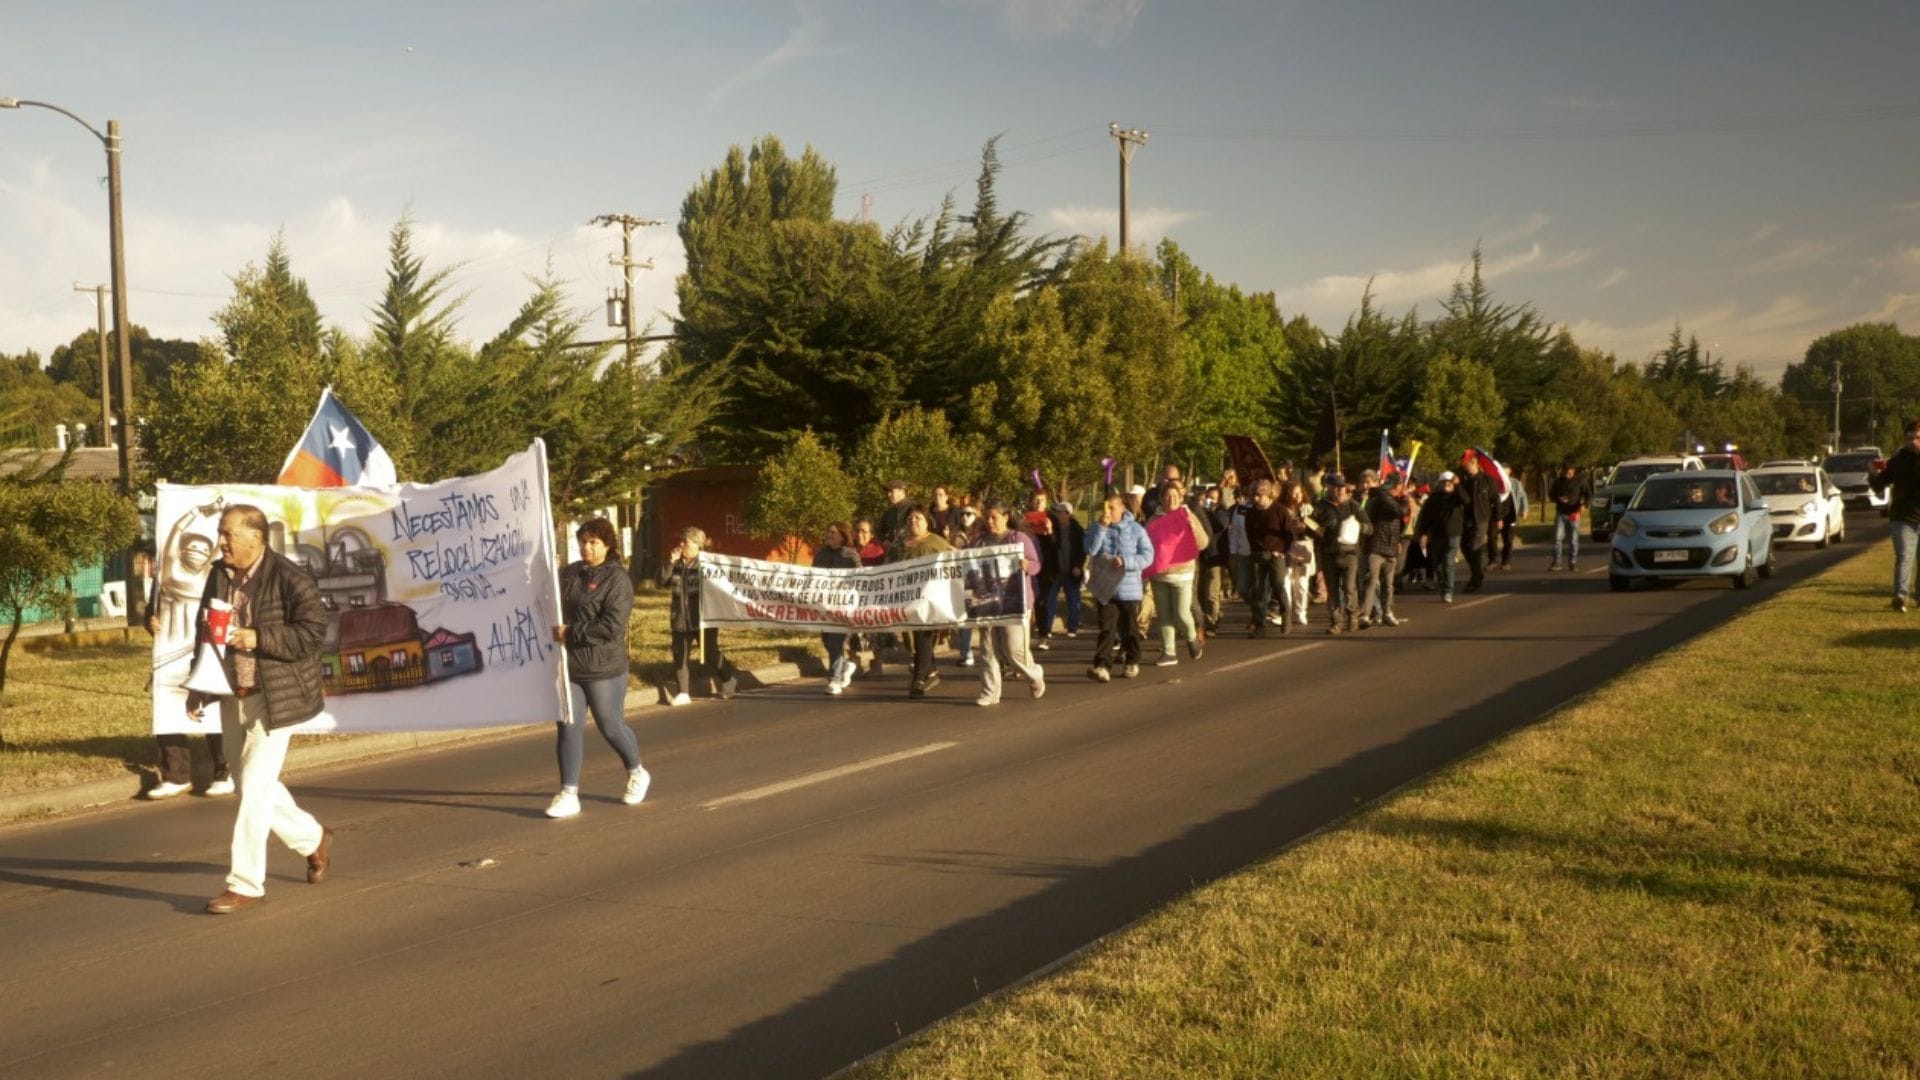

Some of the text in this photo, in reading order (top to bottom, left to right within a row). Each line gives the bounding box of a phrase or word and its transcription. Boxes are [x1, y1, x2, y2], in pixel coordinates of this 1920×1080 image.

[392, 492, 499, 541] NECESITAMOS
[815, 578, 834, 591] LOS
[887, 577, 893, 590] Y
[896, 565, 962, 587] COMPROMISOS
[812, 592, 824, 605] LA
[826, 593, 858, 606] VILLA
